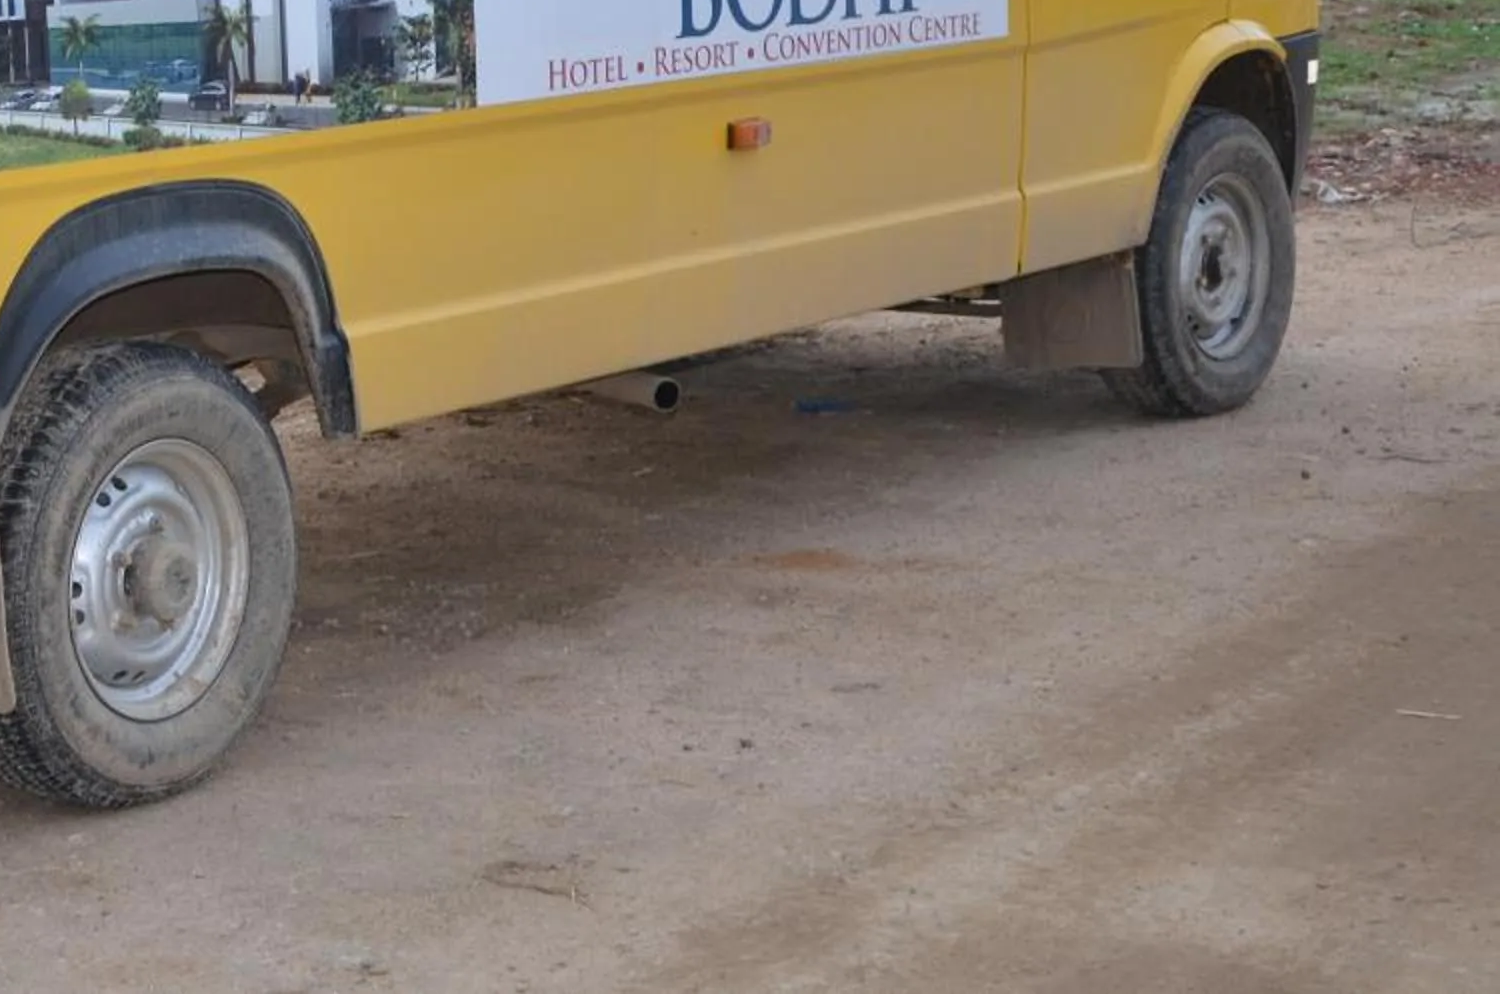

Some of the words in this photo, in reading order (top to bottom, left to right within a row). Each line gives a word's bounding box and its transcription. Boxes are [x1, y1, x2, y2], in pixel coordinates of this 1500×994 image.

[548, 58, 628, 91] HOTEL
[654, 41, 739, 77] RESORT
[763, 19, 901, 62] CONVENTION
[908, 12, 982, 46] CENTRE
